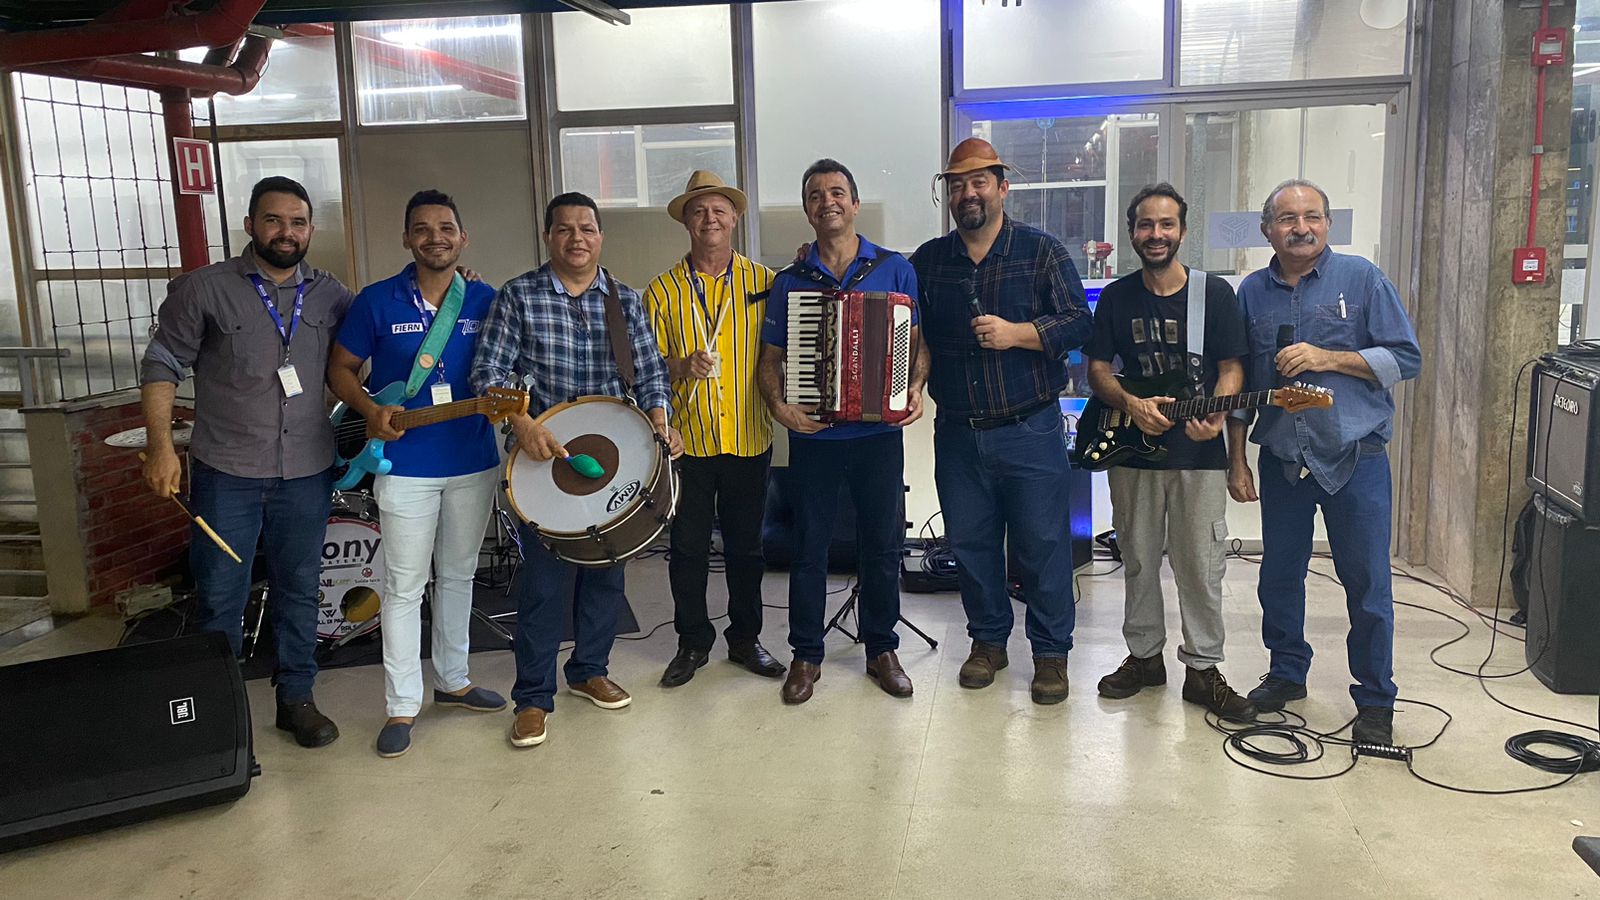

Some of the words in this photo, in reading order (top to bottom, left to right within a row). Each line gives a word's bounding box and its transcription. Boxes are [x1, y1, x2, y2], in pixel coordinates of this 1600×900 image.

[183, 147, 206, 187] H
[394, 323, 421, 333] FIERN
[614, 483, 635, 509] RMV
[321, 538, 382, 564] ony
[176, 702, 189, 719] JBL
